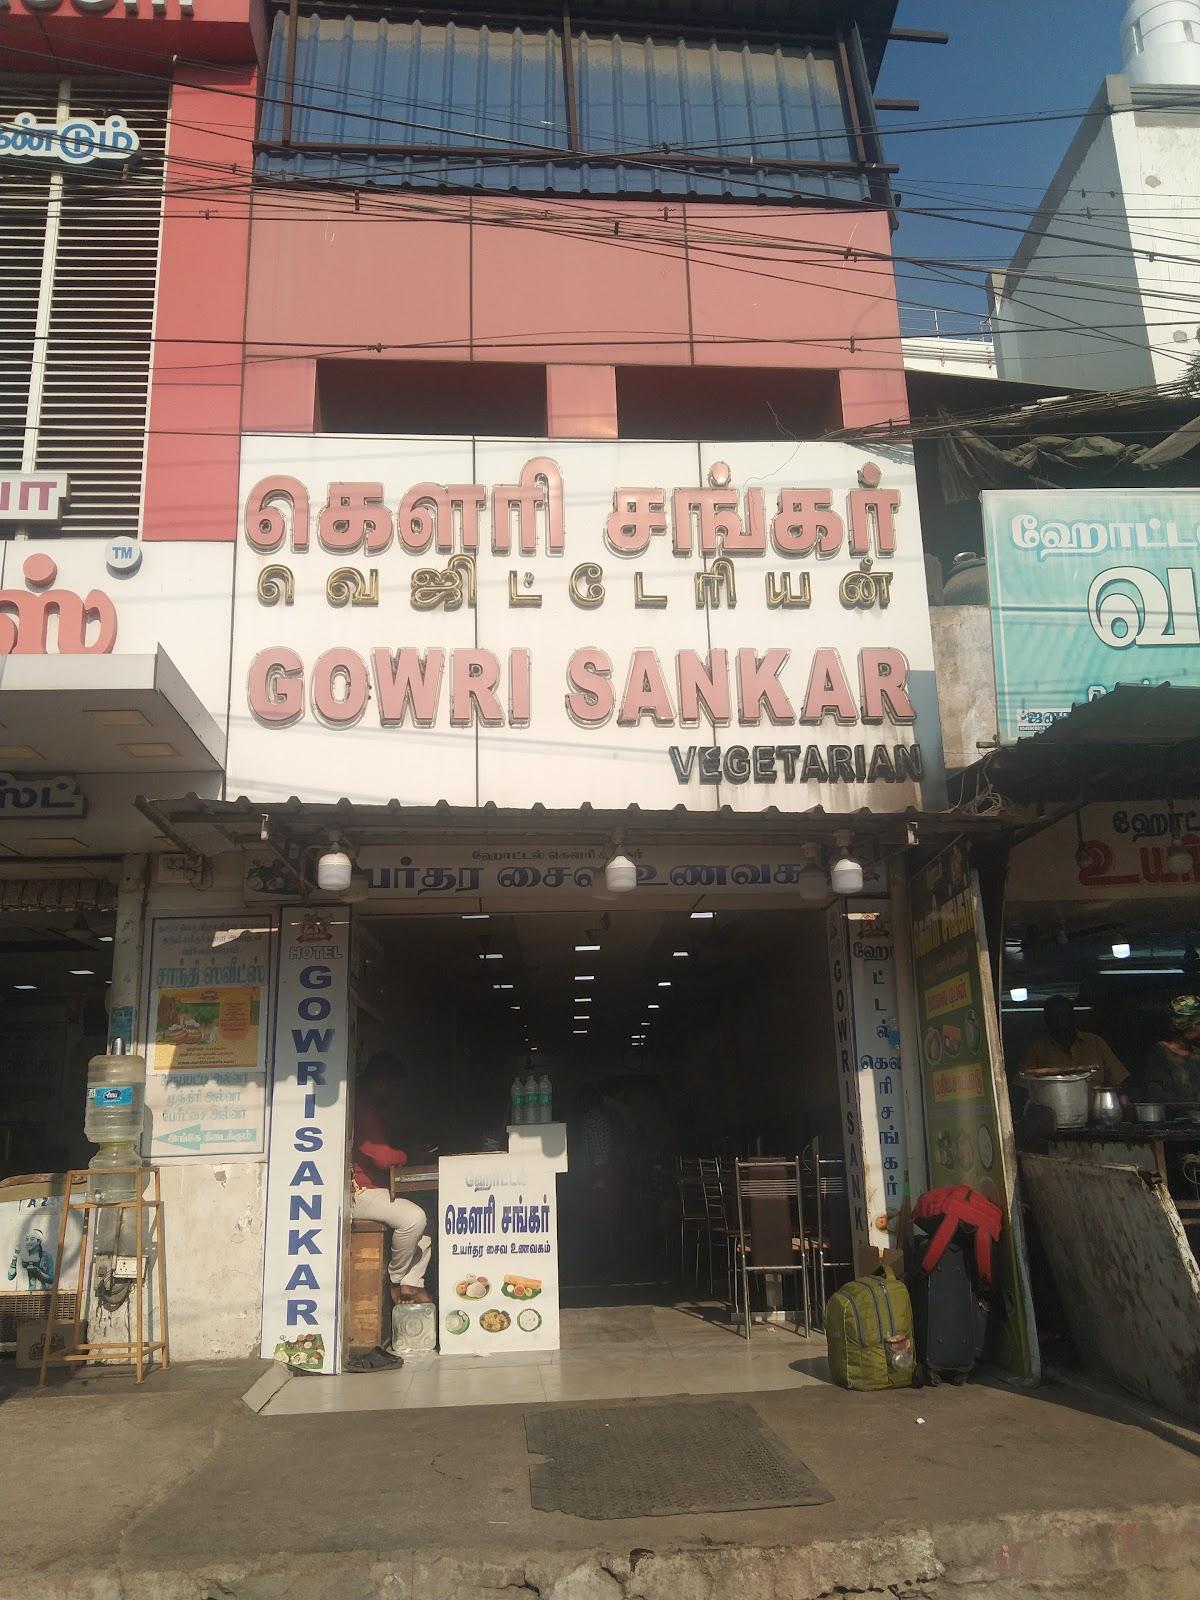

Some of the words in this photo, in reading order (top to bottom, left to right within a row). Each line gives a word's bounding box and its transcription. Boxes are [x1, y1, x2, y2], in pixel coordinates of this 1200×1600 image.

[246, 457, 566, 556] கௌரி
[604, 461, 900, 558] சங்கர்
[112, 547, 132, 559] TM
[1011, 513, 1200, 558] ஹோட்ட
[247, 647, 531, 729] GOWRI
[565, 647, 916, 729] SANKAR
[669, 745, 924, 784] VEGETARIAN
[289, 946, 342, 960] HOTEL
[445, 1194, 495, 1235] கௌரி
[501, 1194, 550, 1233] சங்கர்
[452, 1242, 484, 1258] உயர்தர
[486, 1244, 508, 1255] சைவ
[510, 1240, 551, 1254] உணவகம்
